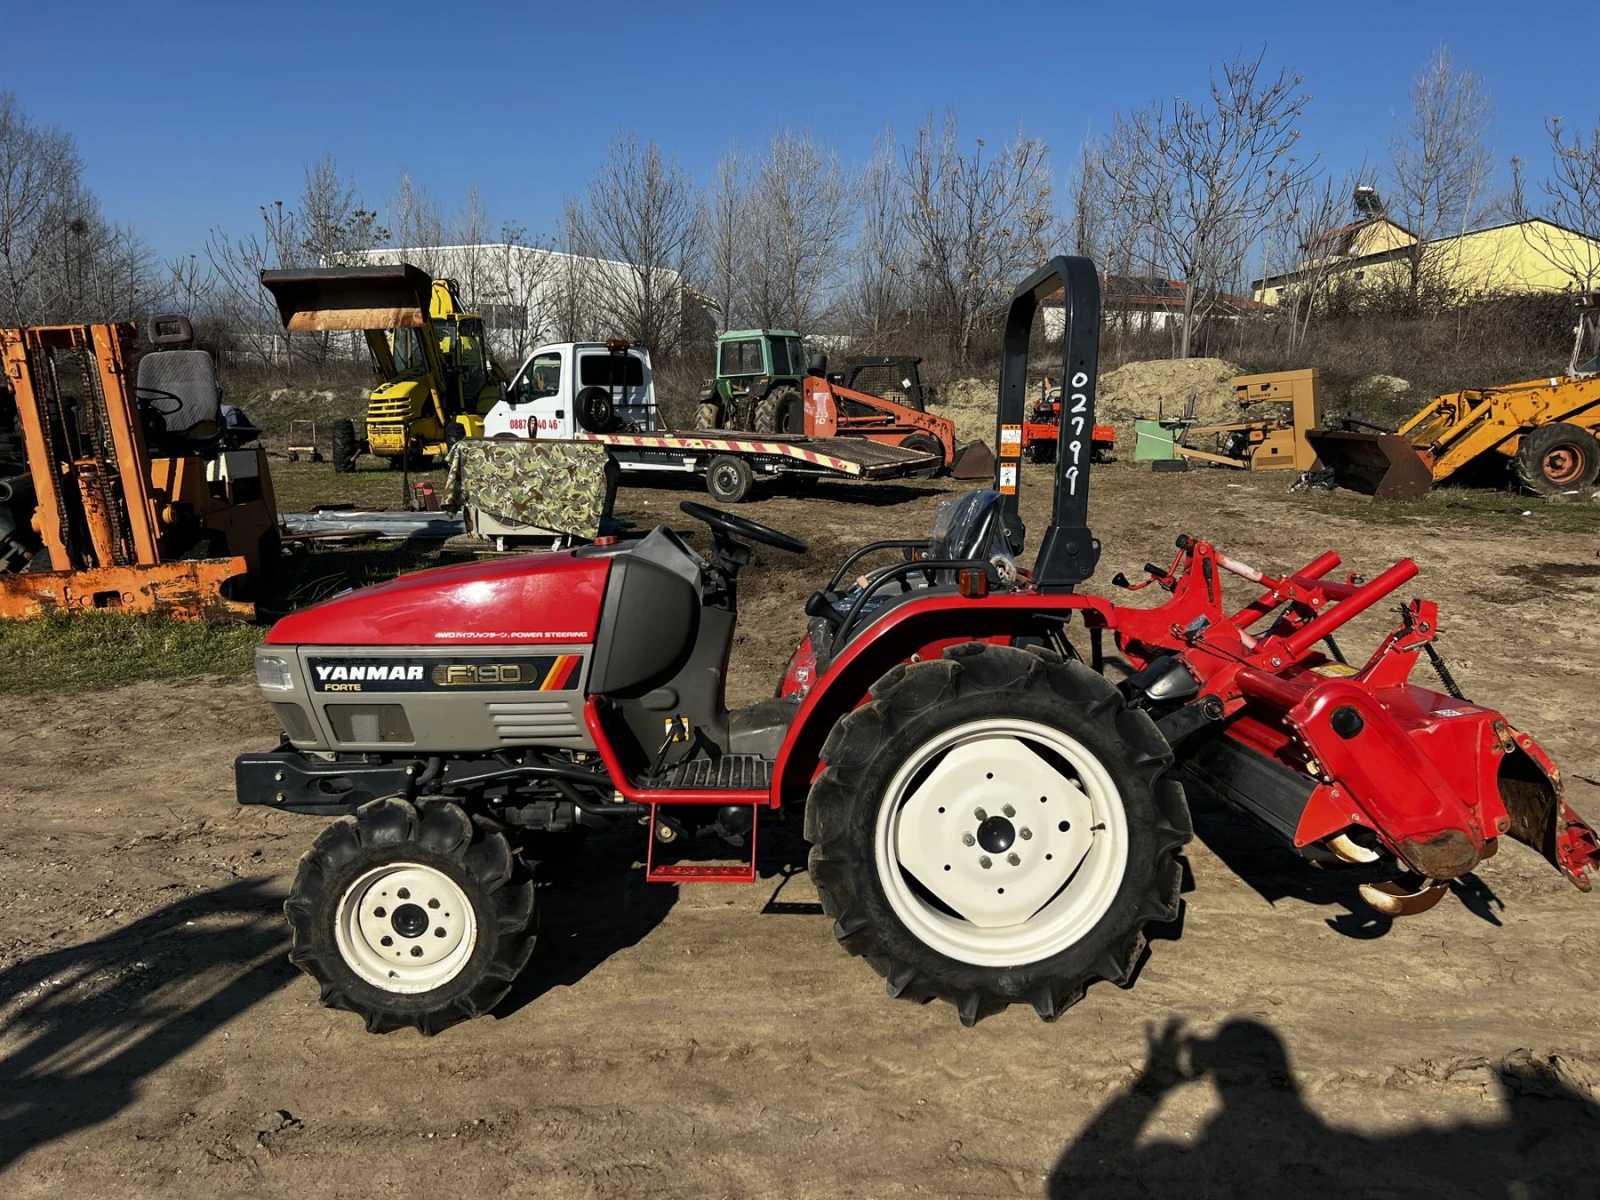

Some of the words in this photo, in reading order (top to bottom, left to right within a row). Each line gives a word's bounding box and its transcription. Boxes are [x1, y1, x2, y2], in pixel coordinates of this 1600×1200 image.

[510, 419, 526, 430] 0887
[538, 419, 547, 430] 40
[549, 419, 558, 430] 46
[1065, 372, 1088, 495] 02799
[316, 666, 424, 680] YANMAR
[447, 665, 521, 683] F190
